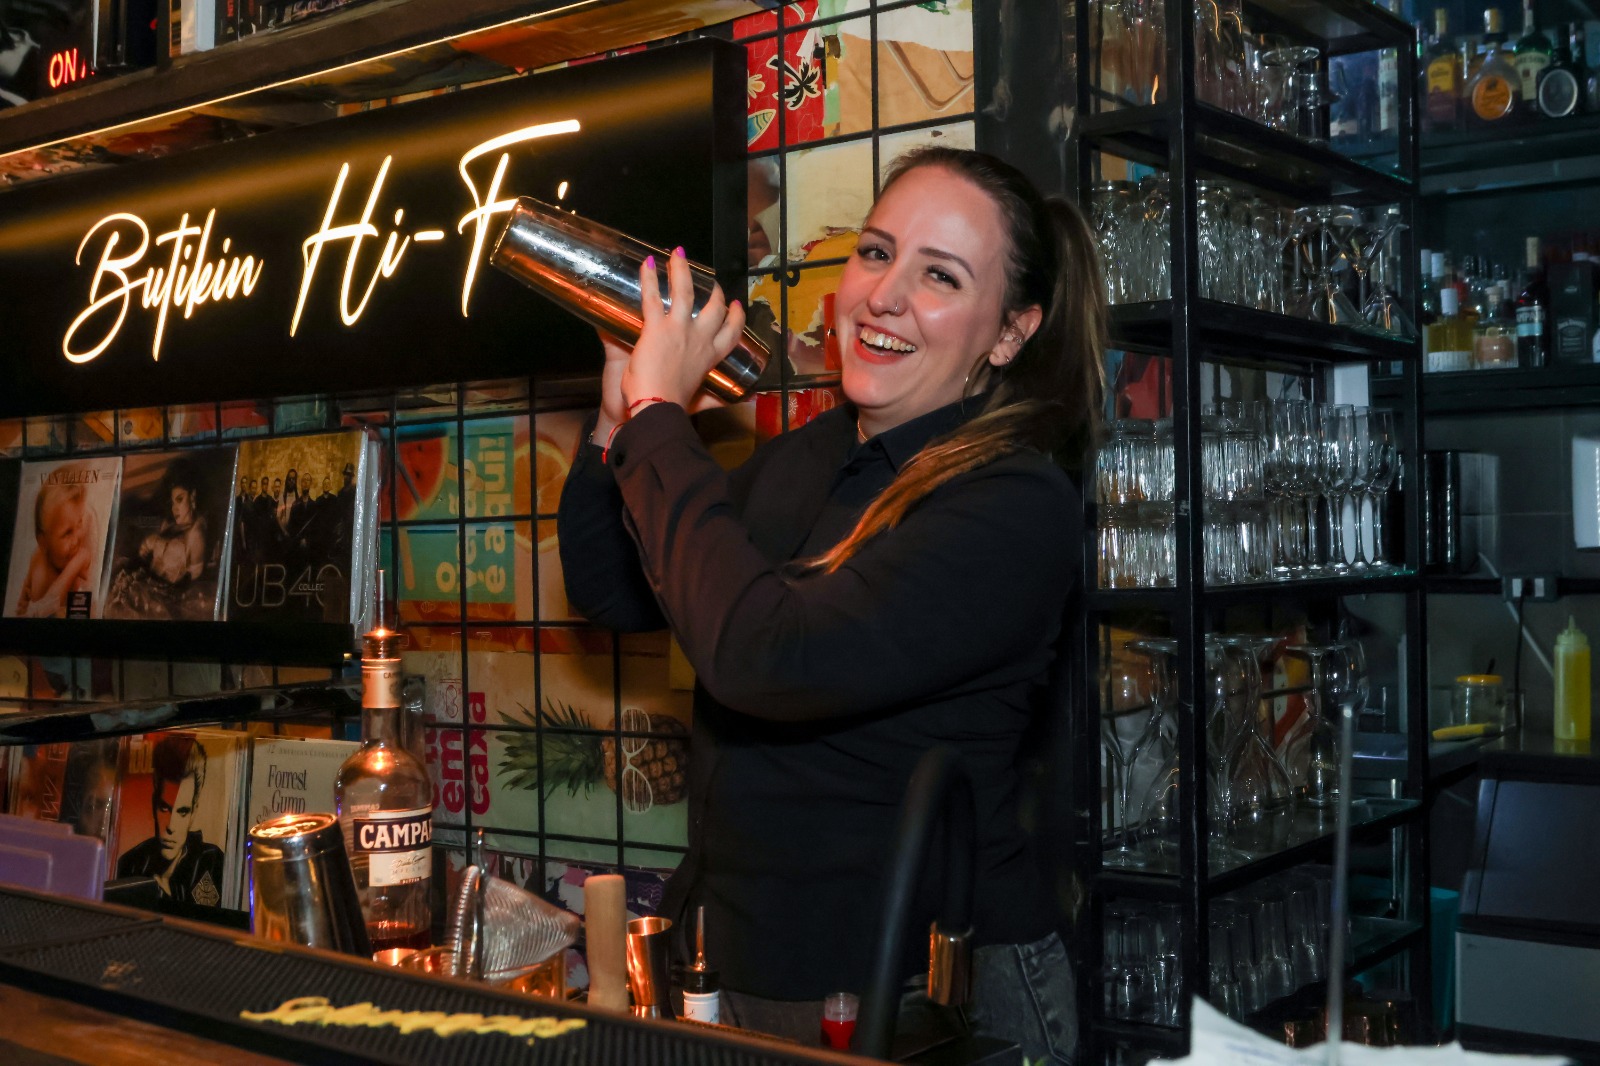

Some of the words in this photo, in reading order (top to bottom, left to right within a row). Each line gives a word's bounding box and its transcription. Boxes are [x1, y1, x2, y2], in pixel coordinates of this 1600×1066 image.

[62, 208, 263, 363] Butikin
[289, 118, 581, 338] Hi-F
[298, 583, 325, 592] COLLEC
[267, 764, 308, 791] Forrest
[359, 819, 433, 850] CAMPA
